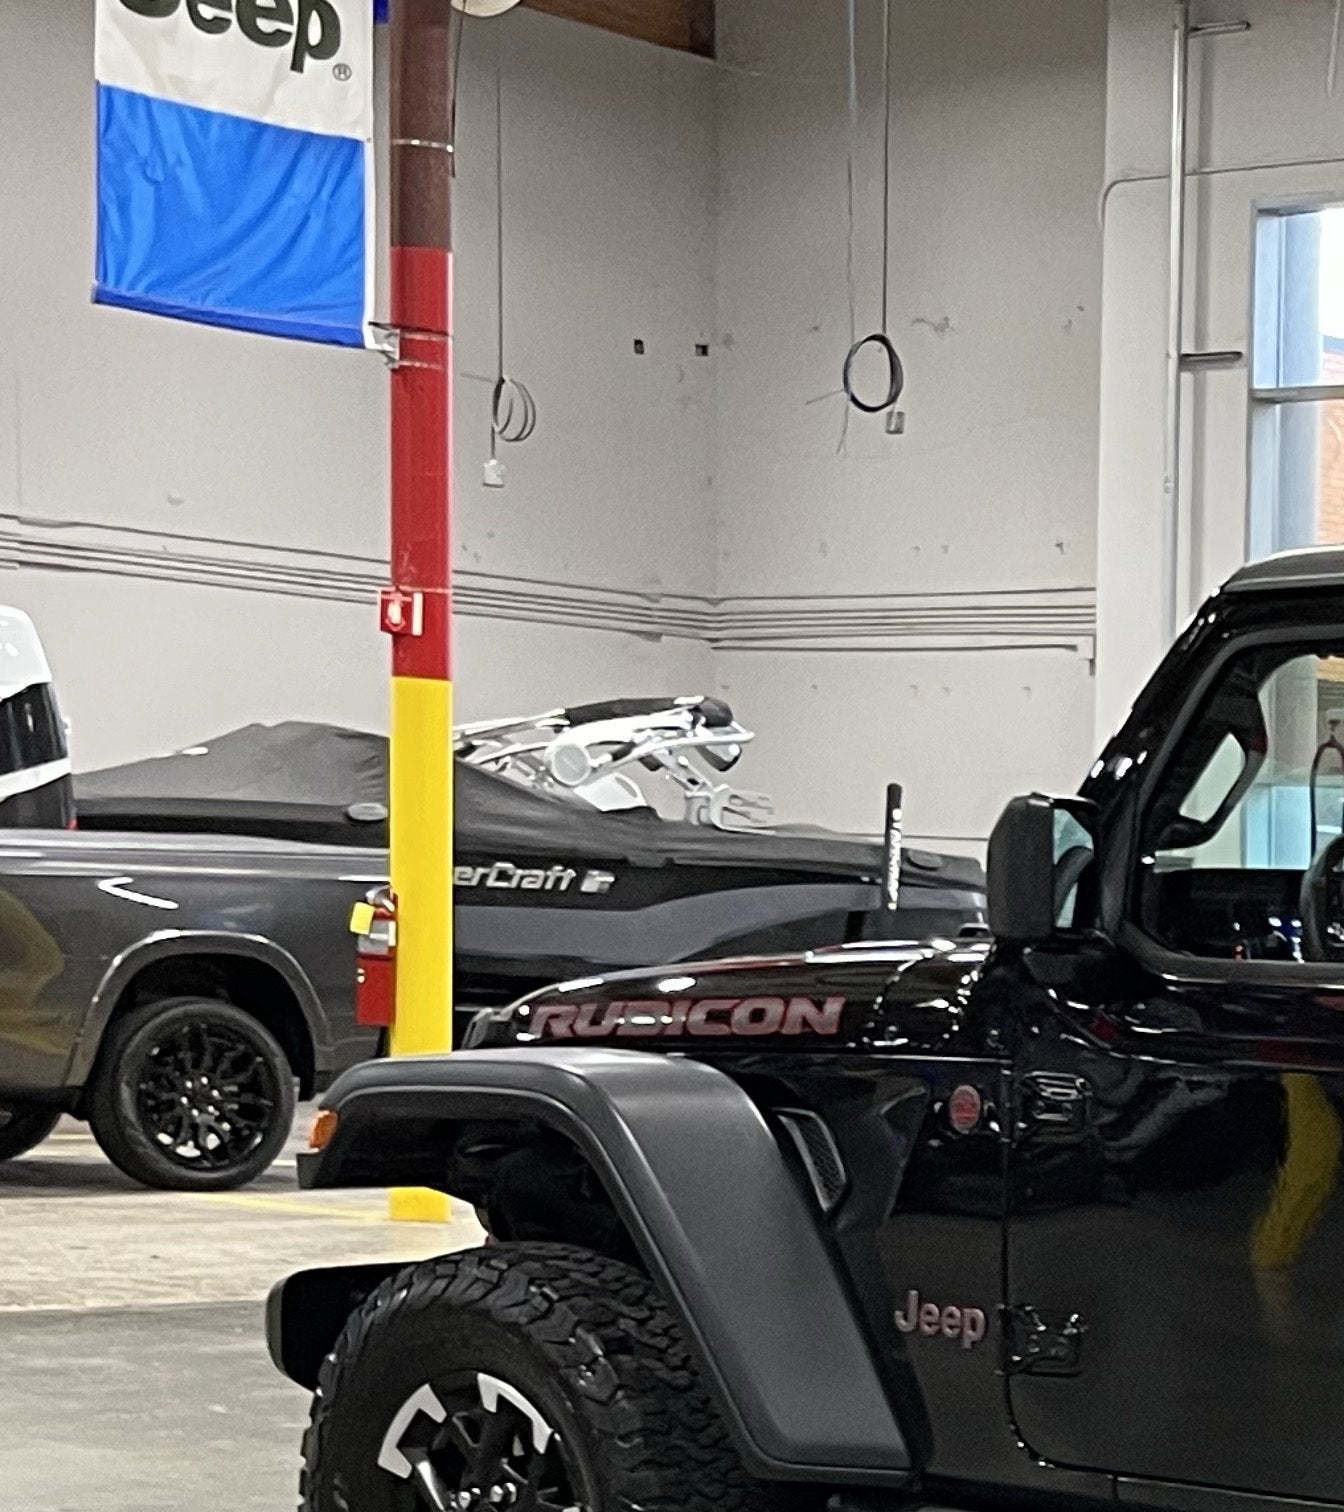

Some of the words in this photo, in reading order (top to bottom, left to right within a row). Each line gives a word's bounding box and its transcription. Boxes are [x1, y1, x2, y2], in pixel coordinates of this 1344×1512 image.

[117, 0, 341, 74] eep
[453, 861, 577, 892] erCraft
[528, 997, 847, 1039] RUBICON
[893, 1289, 987, 1350] Jeep
